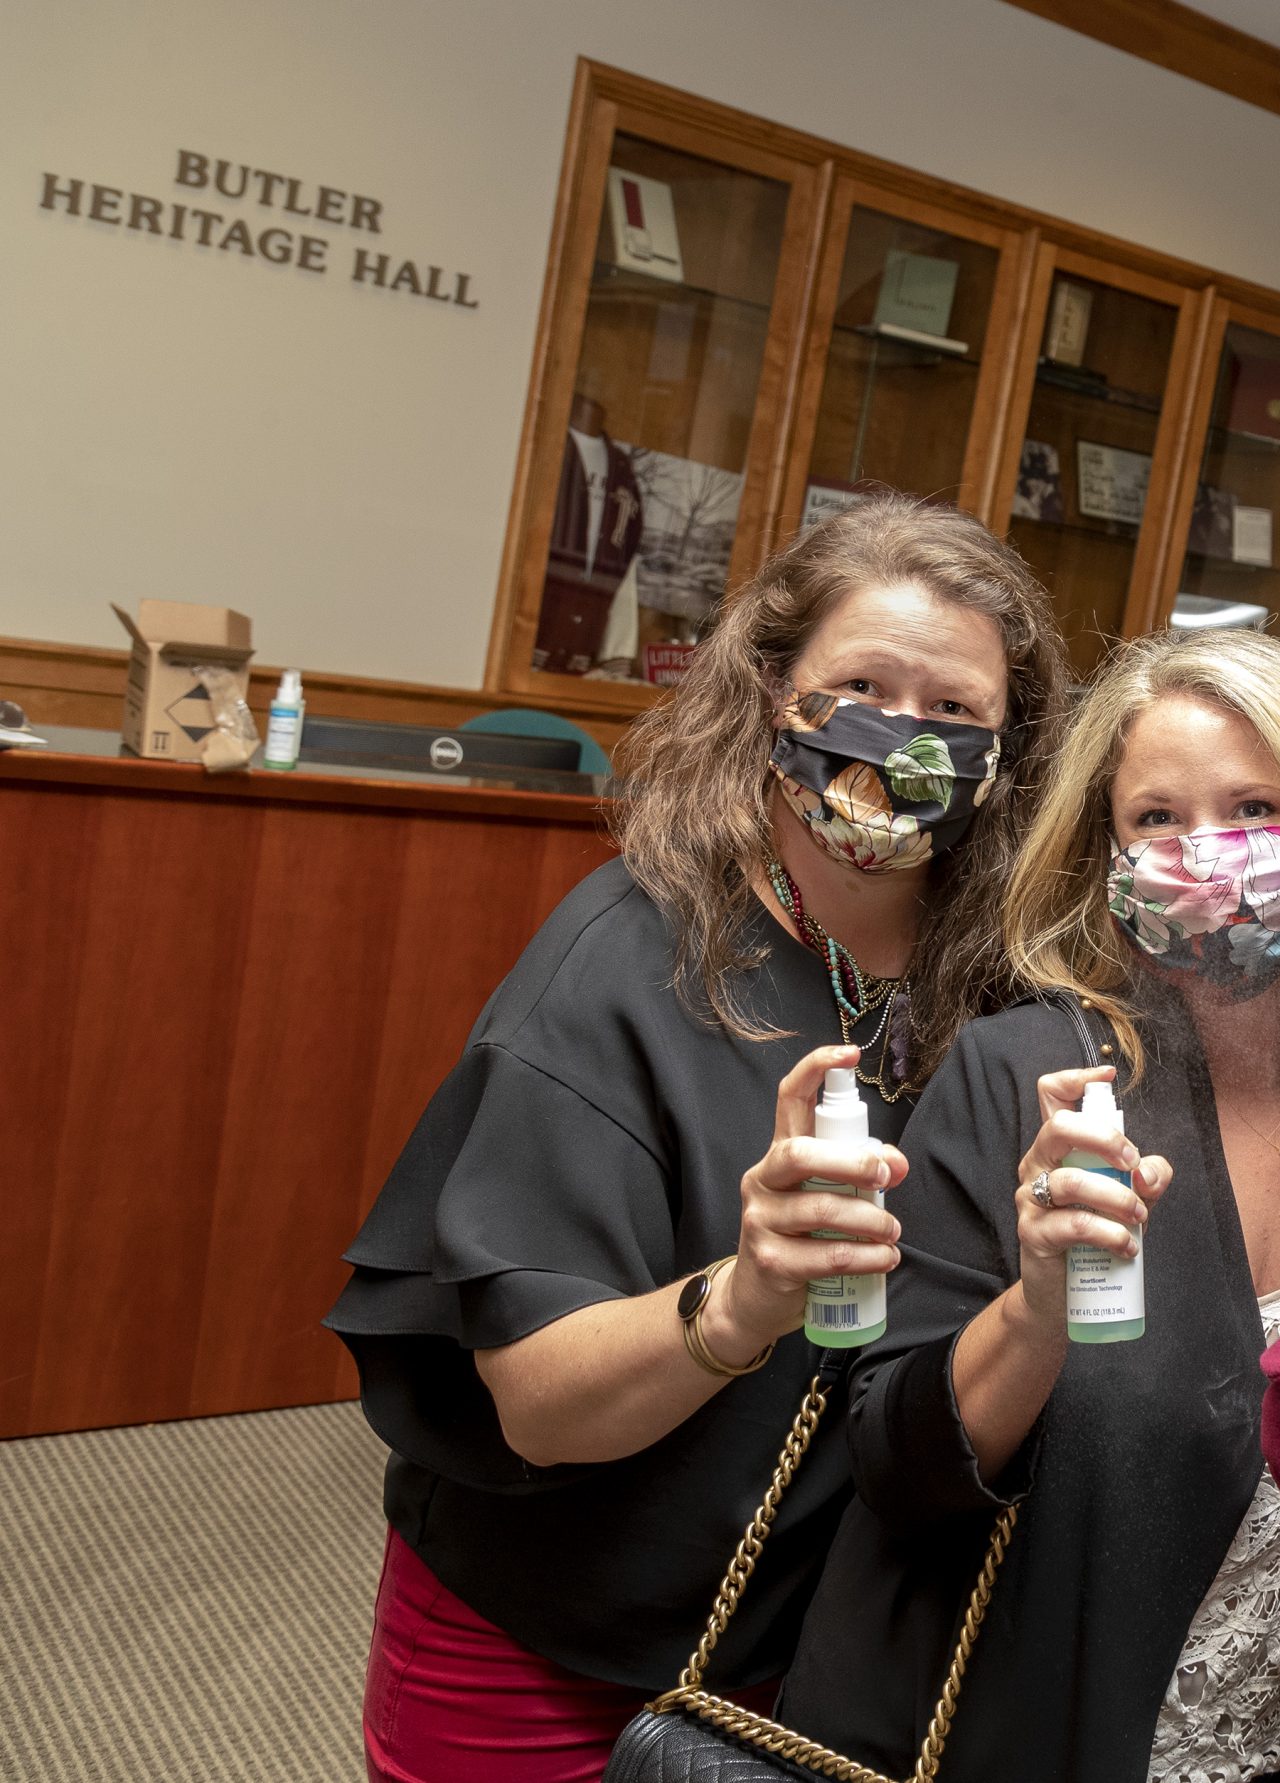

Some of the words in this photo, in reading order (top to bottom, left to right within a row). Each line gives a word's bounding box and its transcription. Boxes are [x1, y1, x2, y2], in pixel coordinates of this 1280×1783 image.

[38, 171, 329, 274] HERITAGE
[351, 248, 480, 310] HALL
[174, 148, 384, 234] BUTLER
